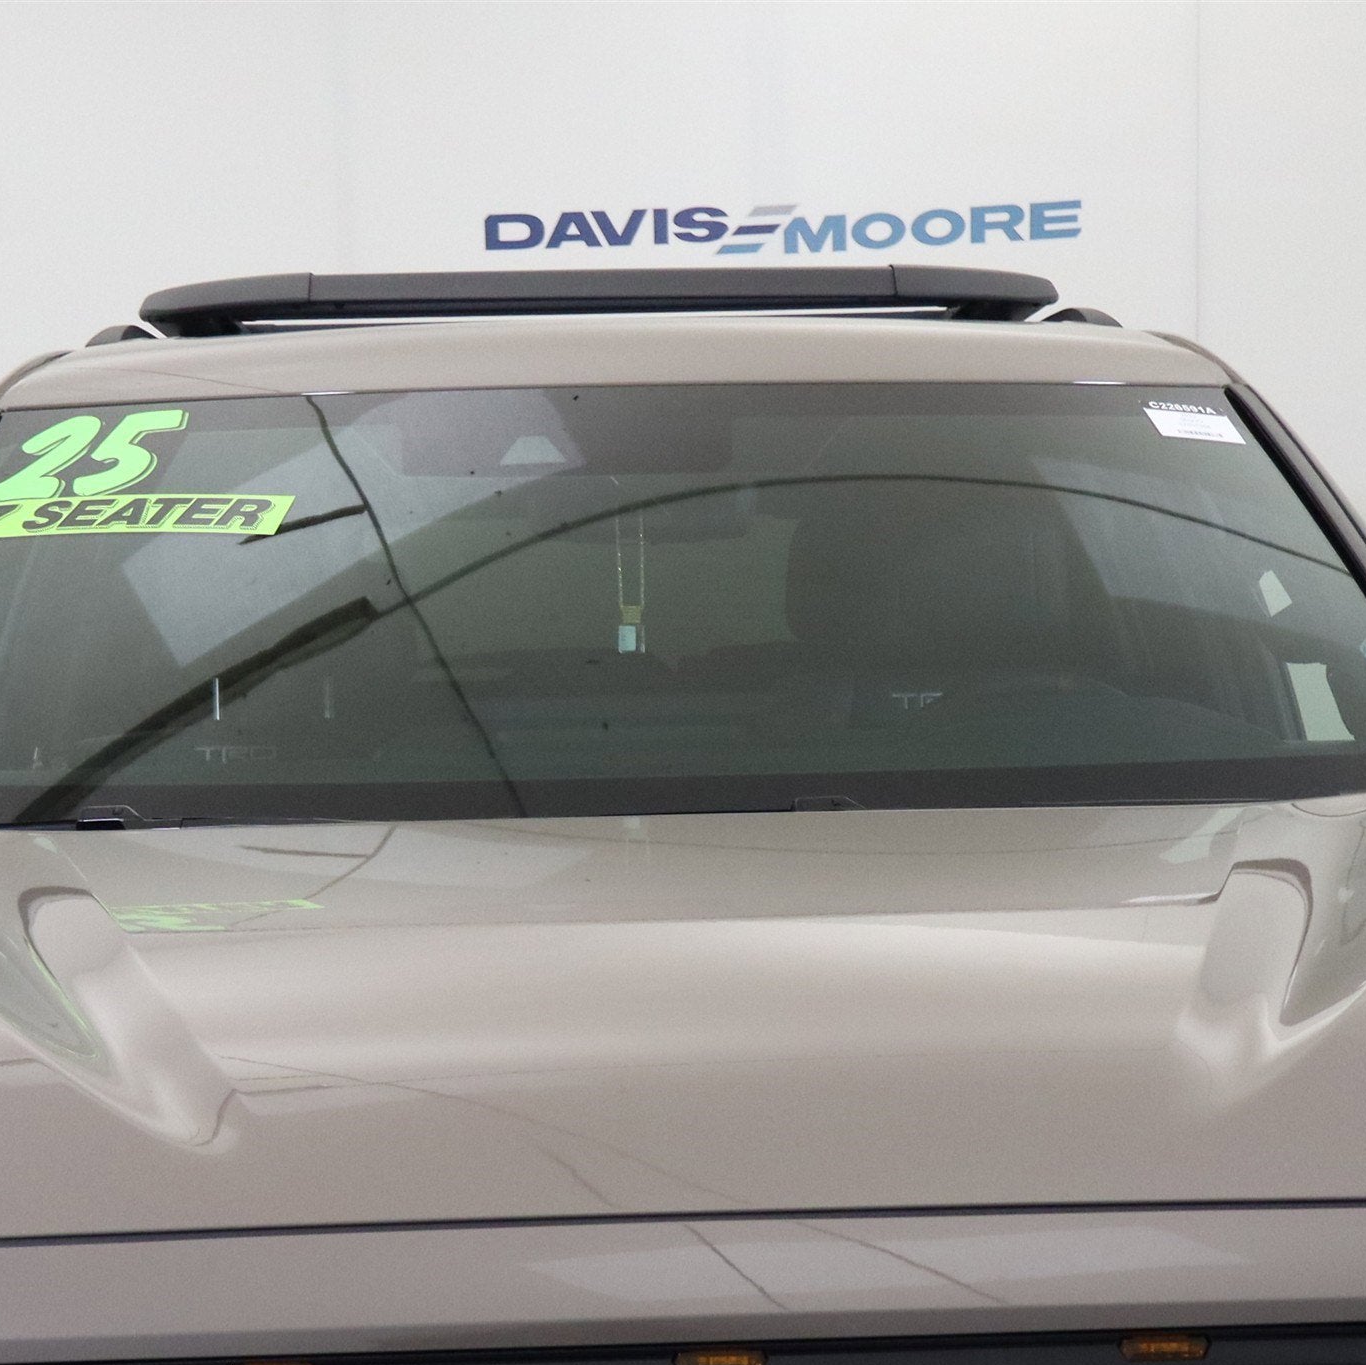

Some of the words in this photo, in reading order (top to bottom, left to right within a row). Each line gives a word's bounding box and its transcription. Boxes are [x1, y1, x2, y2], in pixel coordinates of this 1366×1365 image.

[484, 207, 729, 251] DAVIS
[783, 199, 1082, 255] MOORE
[22, 497, 276, 532] SEATER
